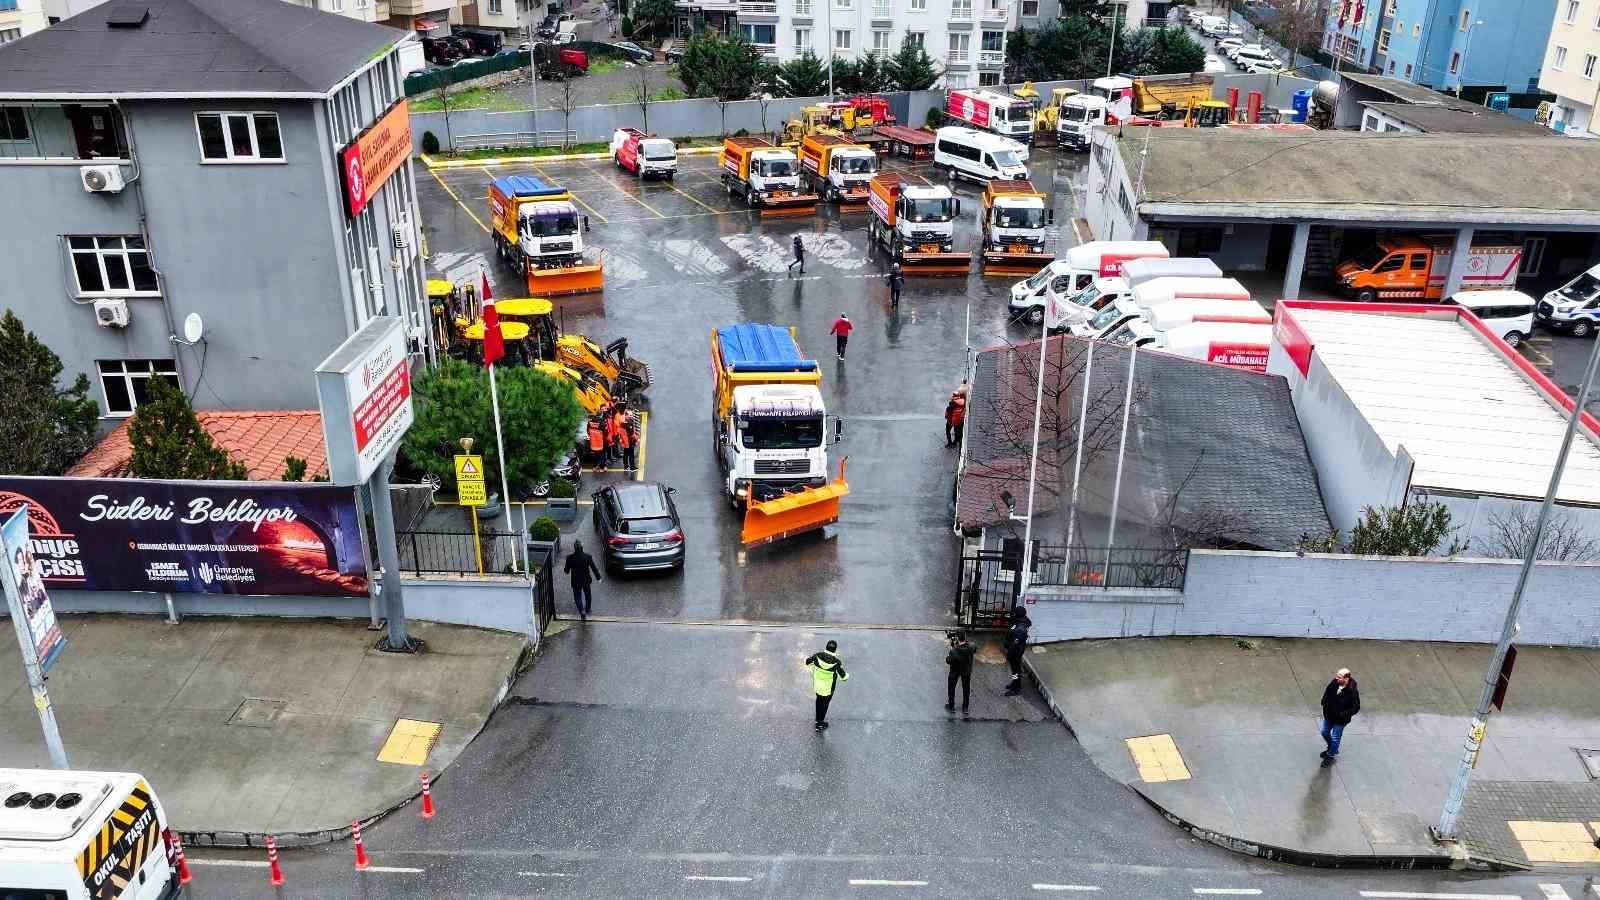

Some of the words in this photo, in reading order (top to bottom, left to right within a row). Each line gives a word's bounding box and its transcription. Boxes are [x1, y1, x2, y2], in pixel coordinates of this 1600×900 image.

[1229, 354, 1267, 365] MÜDAHALE
[80, 494, 175, 522] Sizleri
[181, 497, 297, 532] Bekliyor
[213, 564, 254, 575] Ümraniye
[215, 573, 256, 582] Belediyesi
[93, 853, 120, 886] OKUL
[125, 808, 152, 846] TAŞITI
